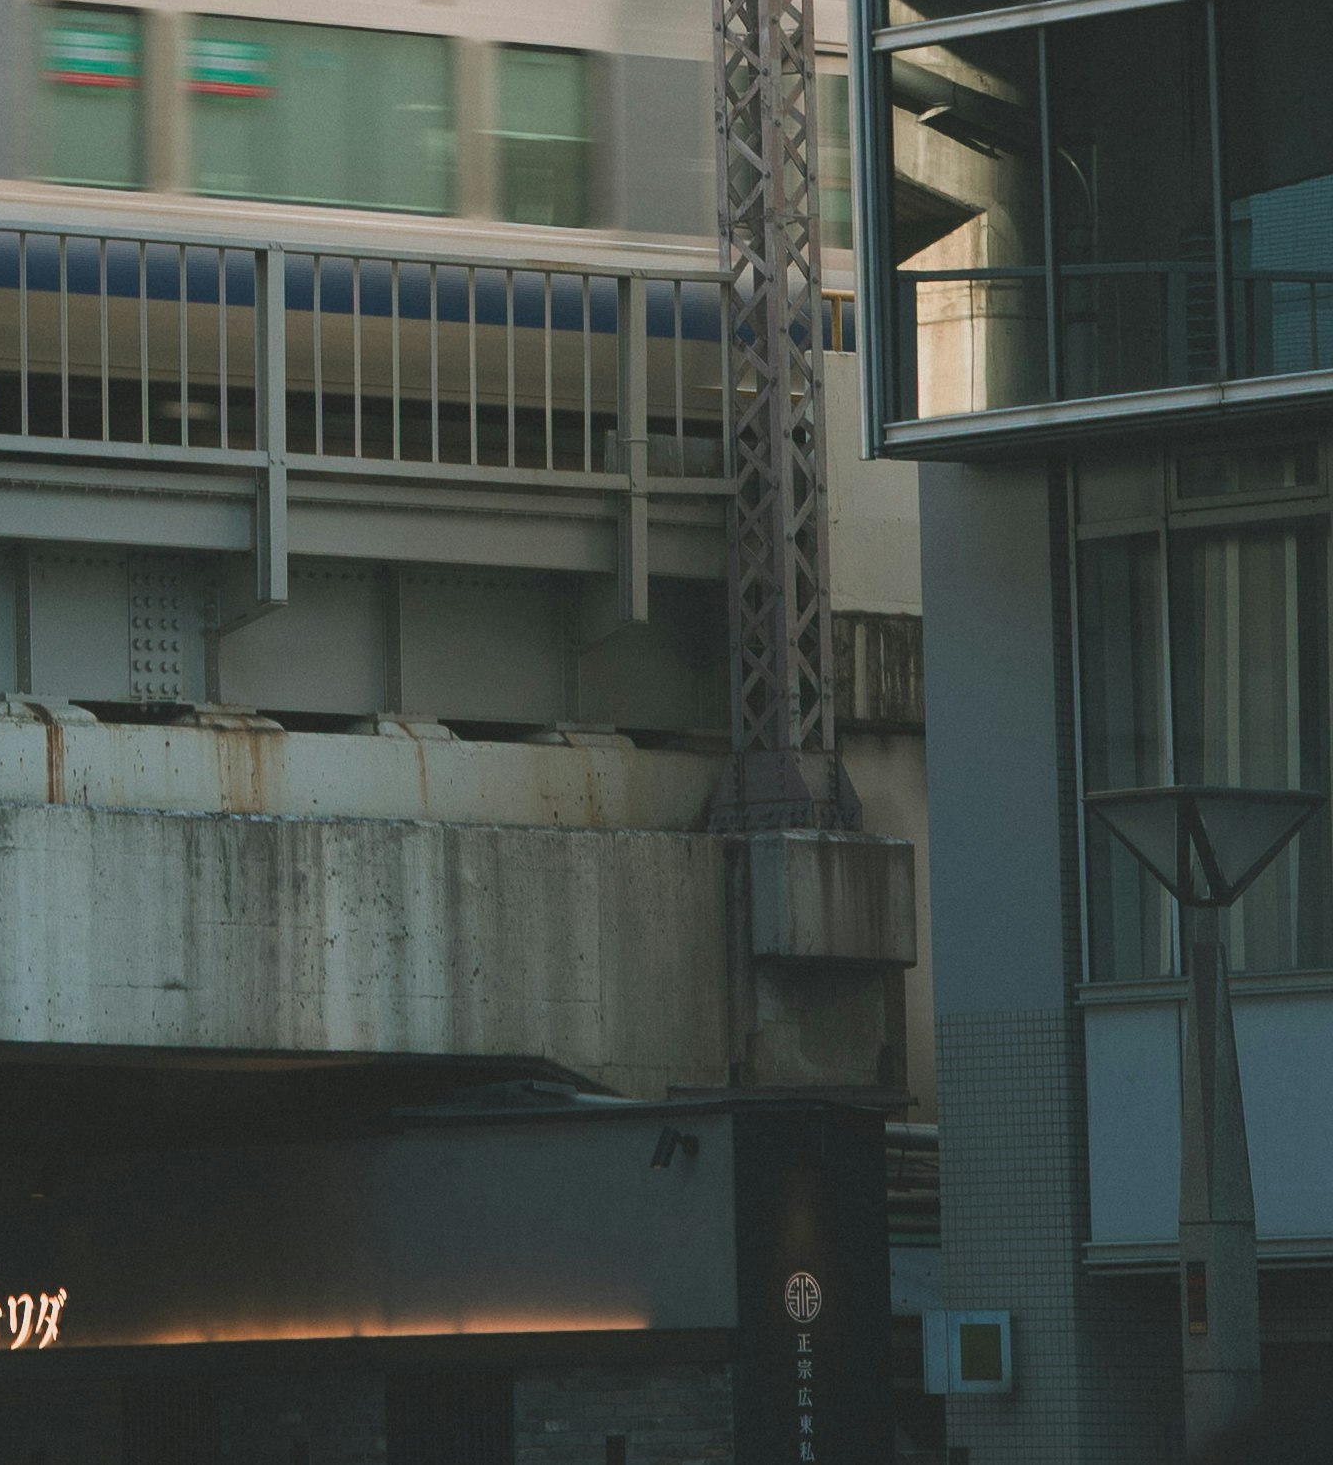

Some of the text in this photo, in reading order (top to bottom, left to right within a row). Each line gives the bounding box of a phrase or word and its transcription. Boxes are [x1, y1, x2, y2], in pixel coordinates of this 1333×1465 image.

[796, 1333, 815, 1462] 正宗広東私
